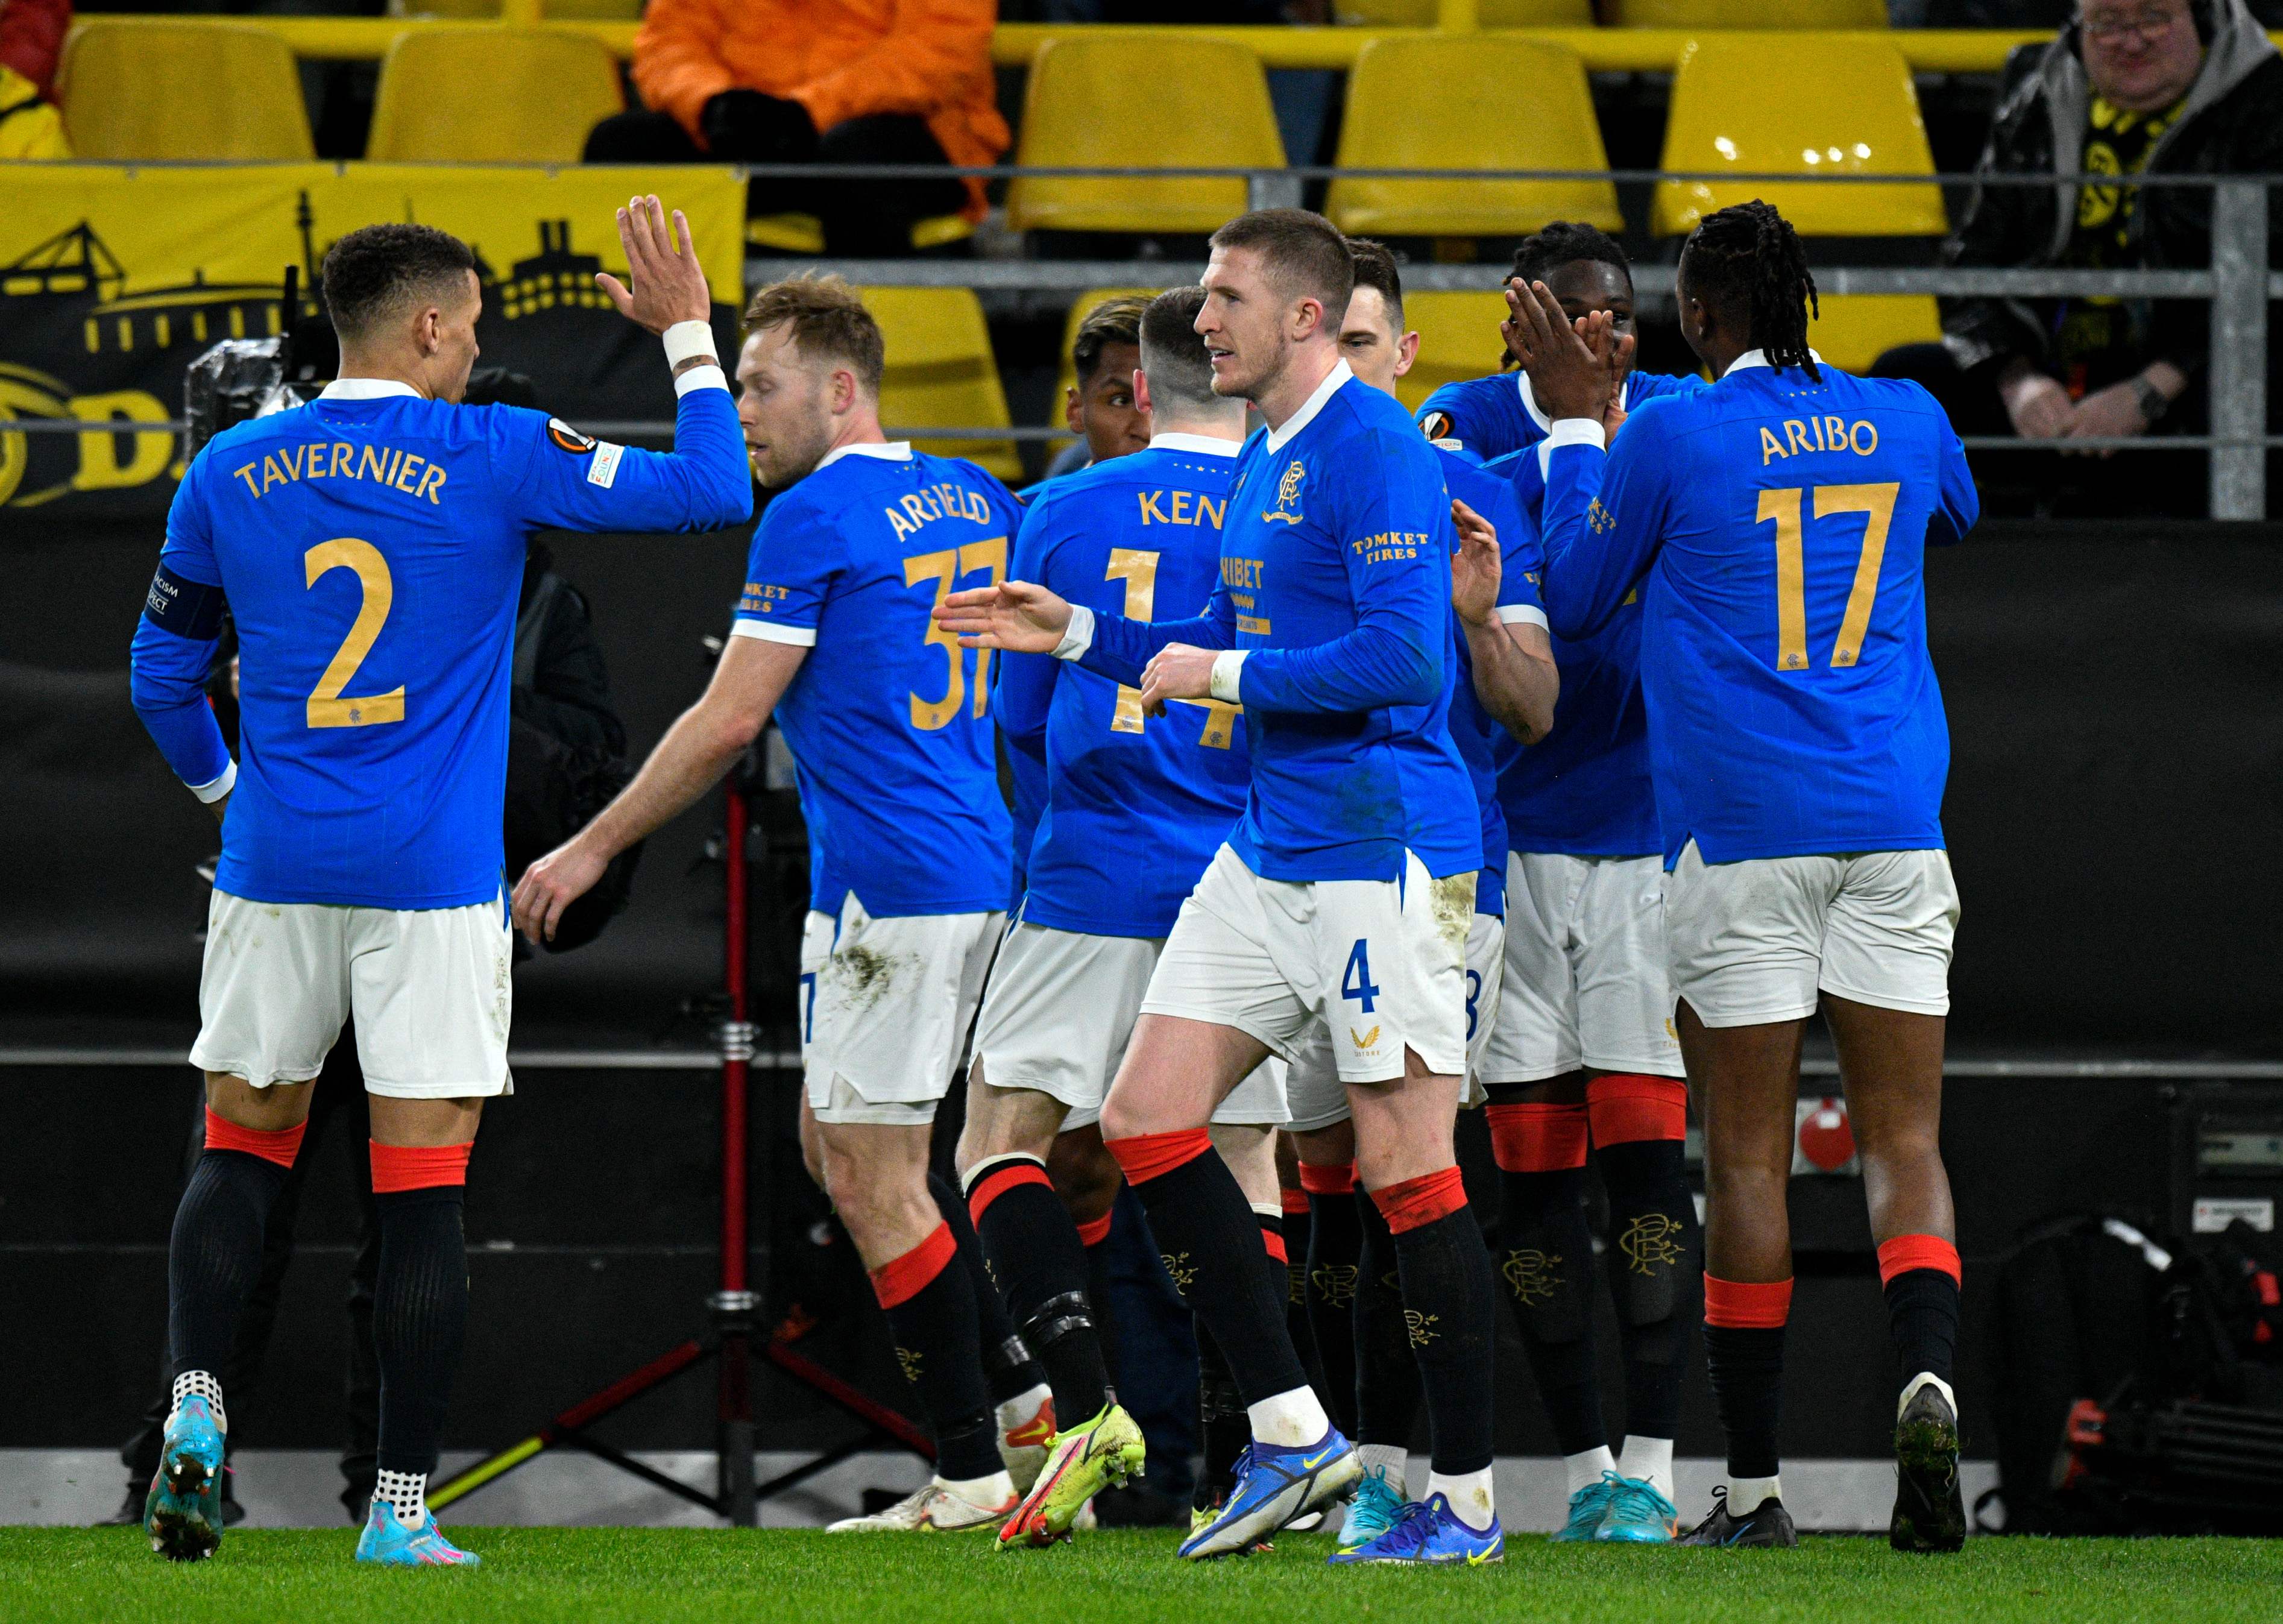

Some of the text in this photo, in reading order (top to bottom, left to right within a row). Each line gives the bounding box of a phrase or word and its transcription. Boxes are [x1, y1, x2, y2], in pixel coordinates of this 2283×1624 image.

[1760, 416, 1878, 466] ARIBO
[233, 442, 447, 505] TAVERNIER
[885, 483, 990, 543] ARFIELD
[1352, 531, 1429, 555] TOMKET
[1366, 548, 1417, 565] TIRES
[1756, 482, 1901, 672] 17
[304, 537, 405, 728] 2
[902, 536, 1008, 731] 37
[1341, 938, 1380, 1014] 4
